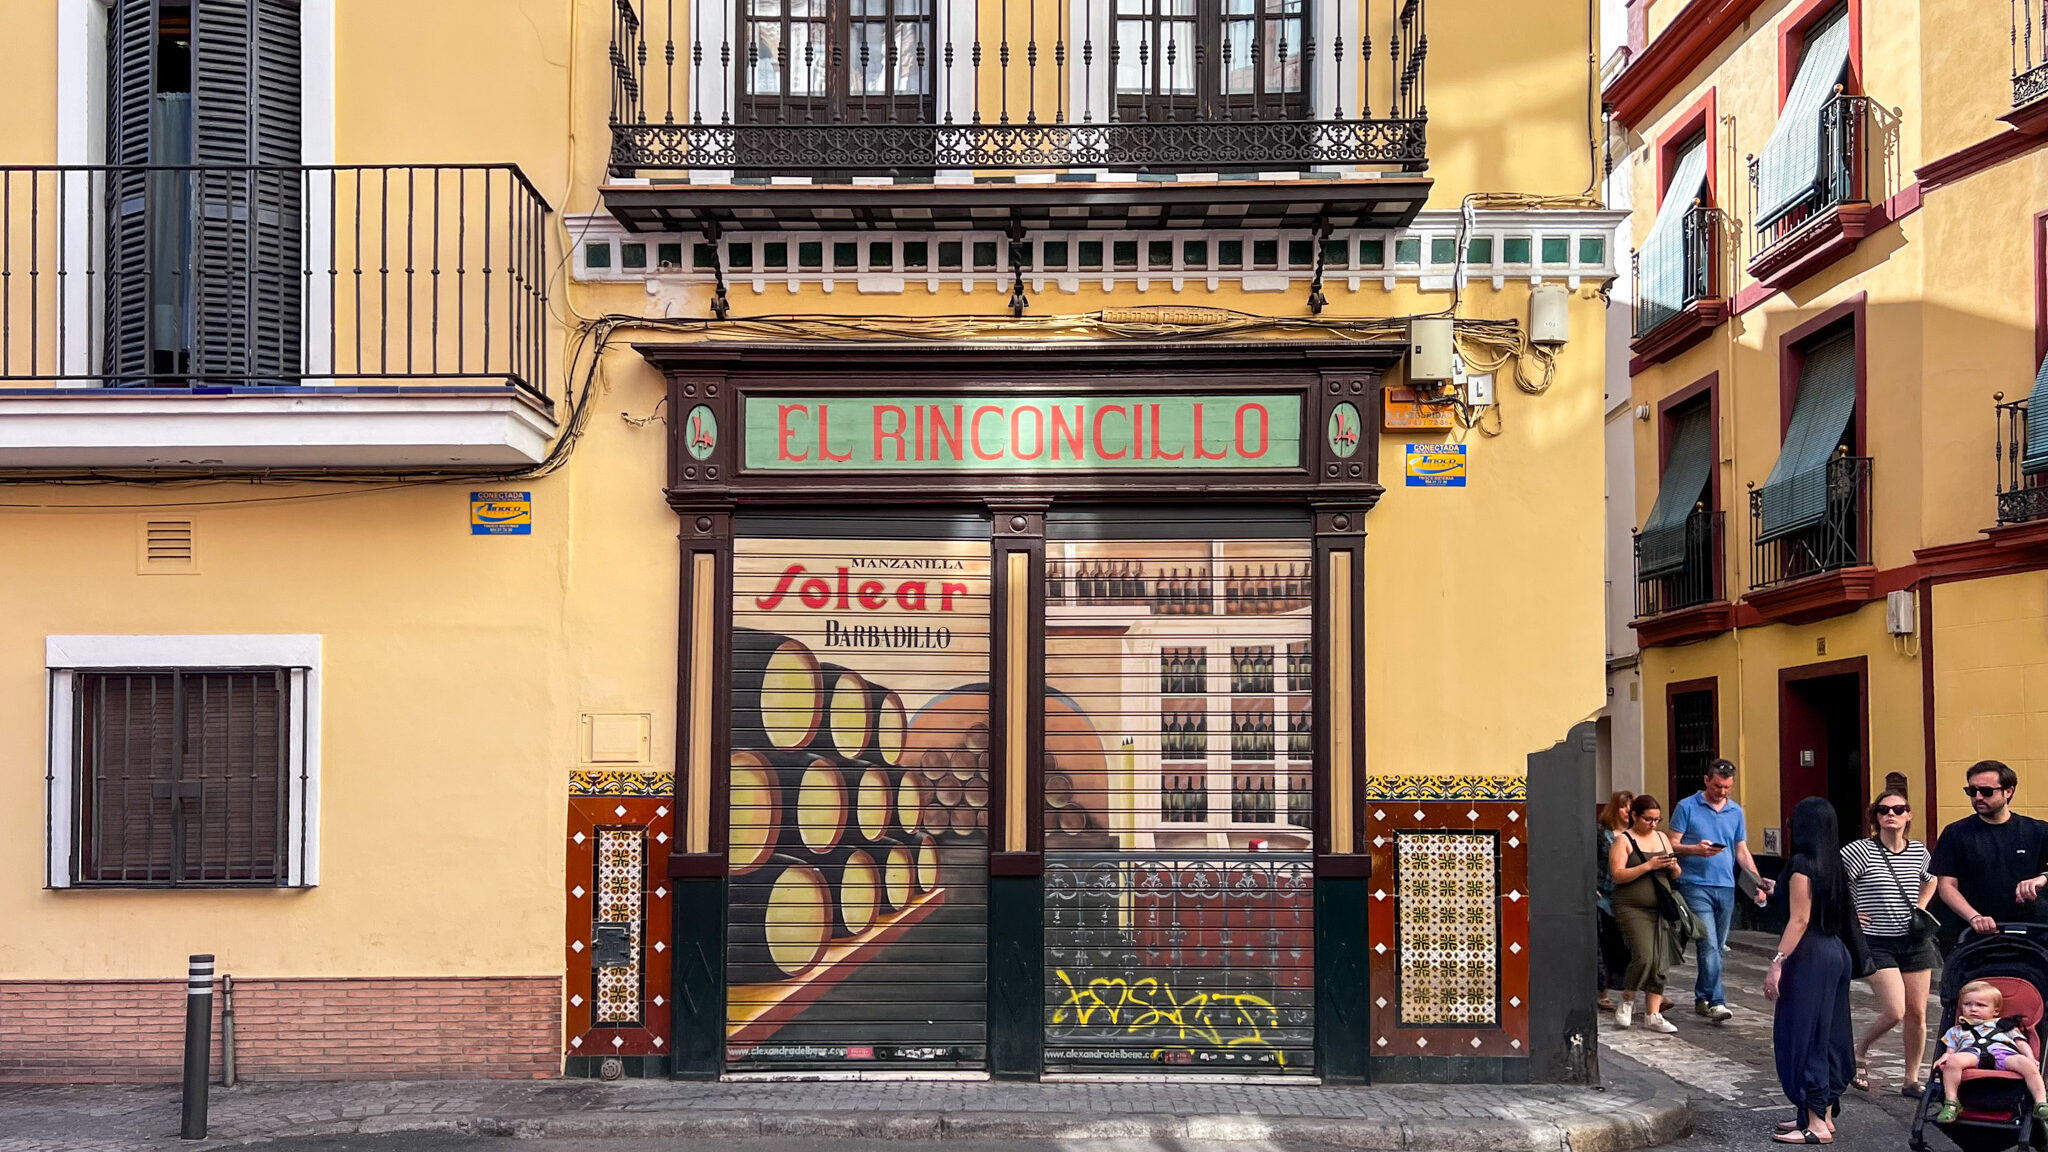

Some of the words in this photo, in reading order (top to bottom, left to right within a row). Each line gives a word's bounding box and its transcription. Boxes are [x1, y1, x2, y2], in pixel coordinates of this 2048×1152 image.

[777, 404, 853, 462] EL
[873, 402, 1269, 462] RINCONCILLO
[851, 558, 964, 569] MANZANILLA
[755, 563, 968, 611] Solear
[824, 619, 951, 649] BARBADILLO
